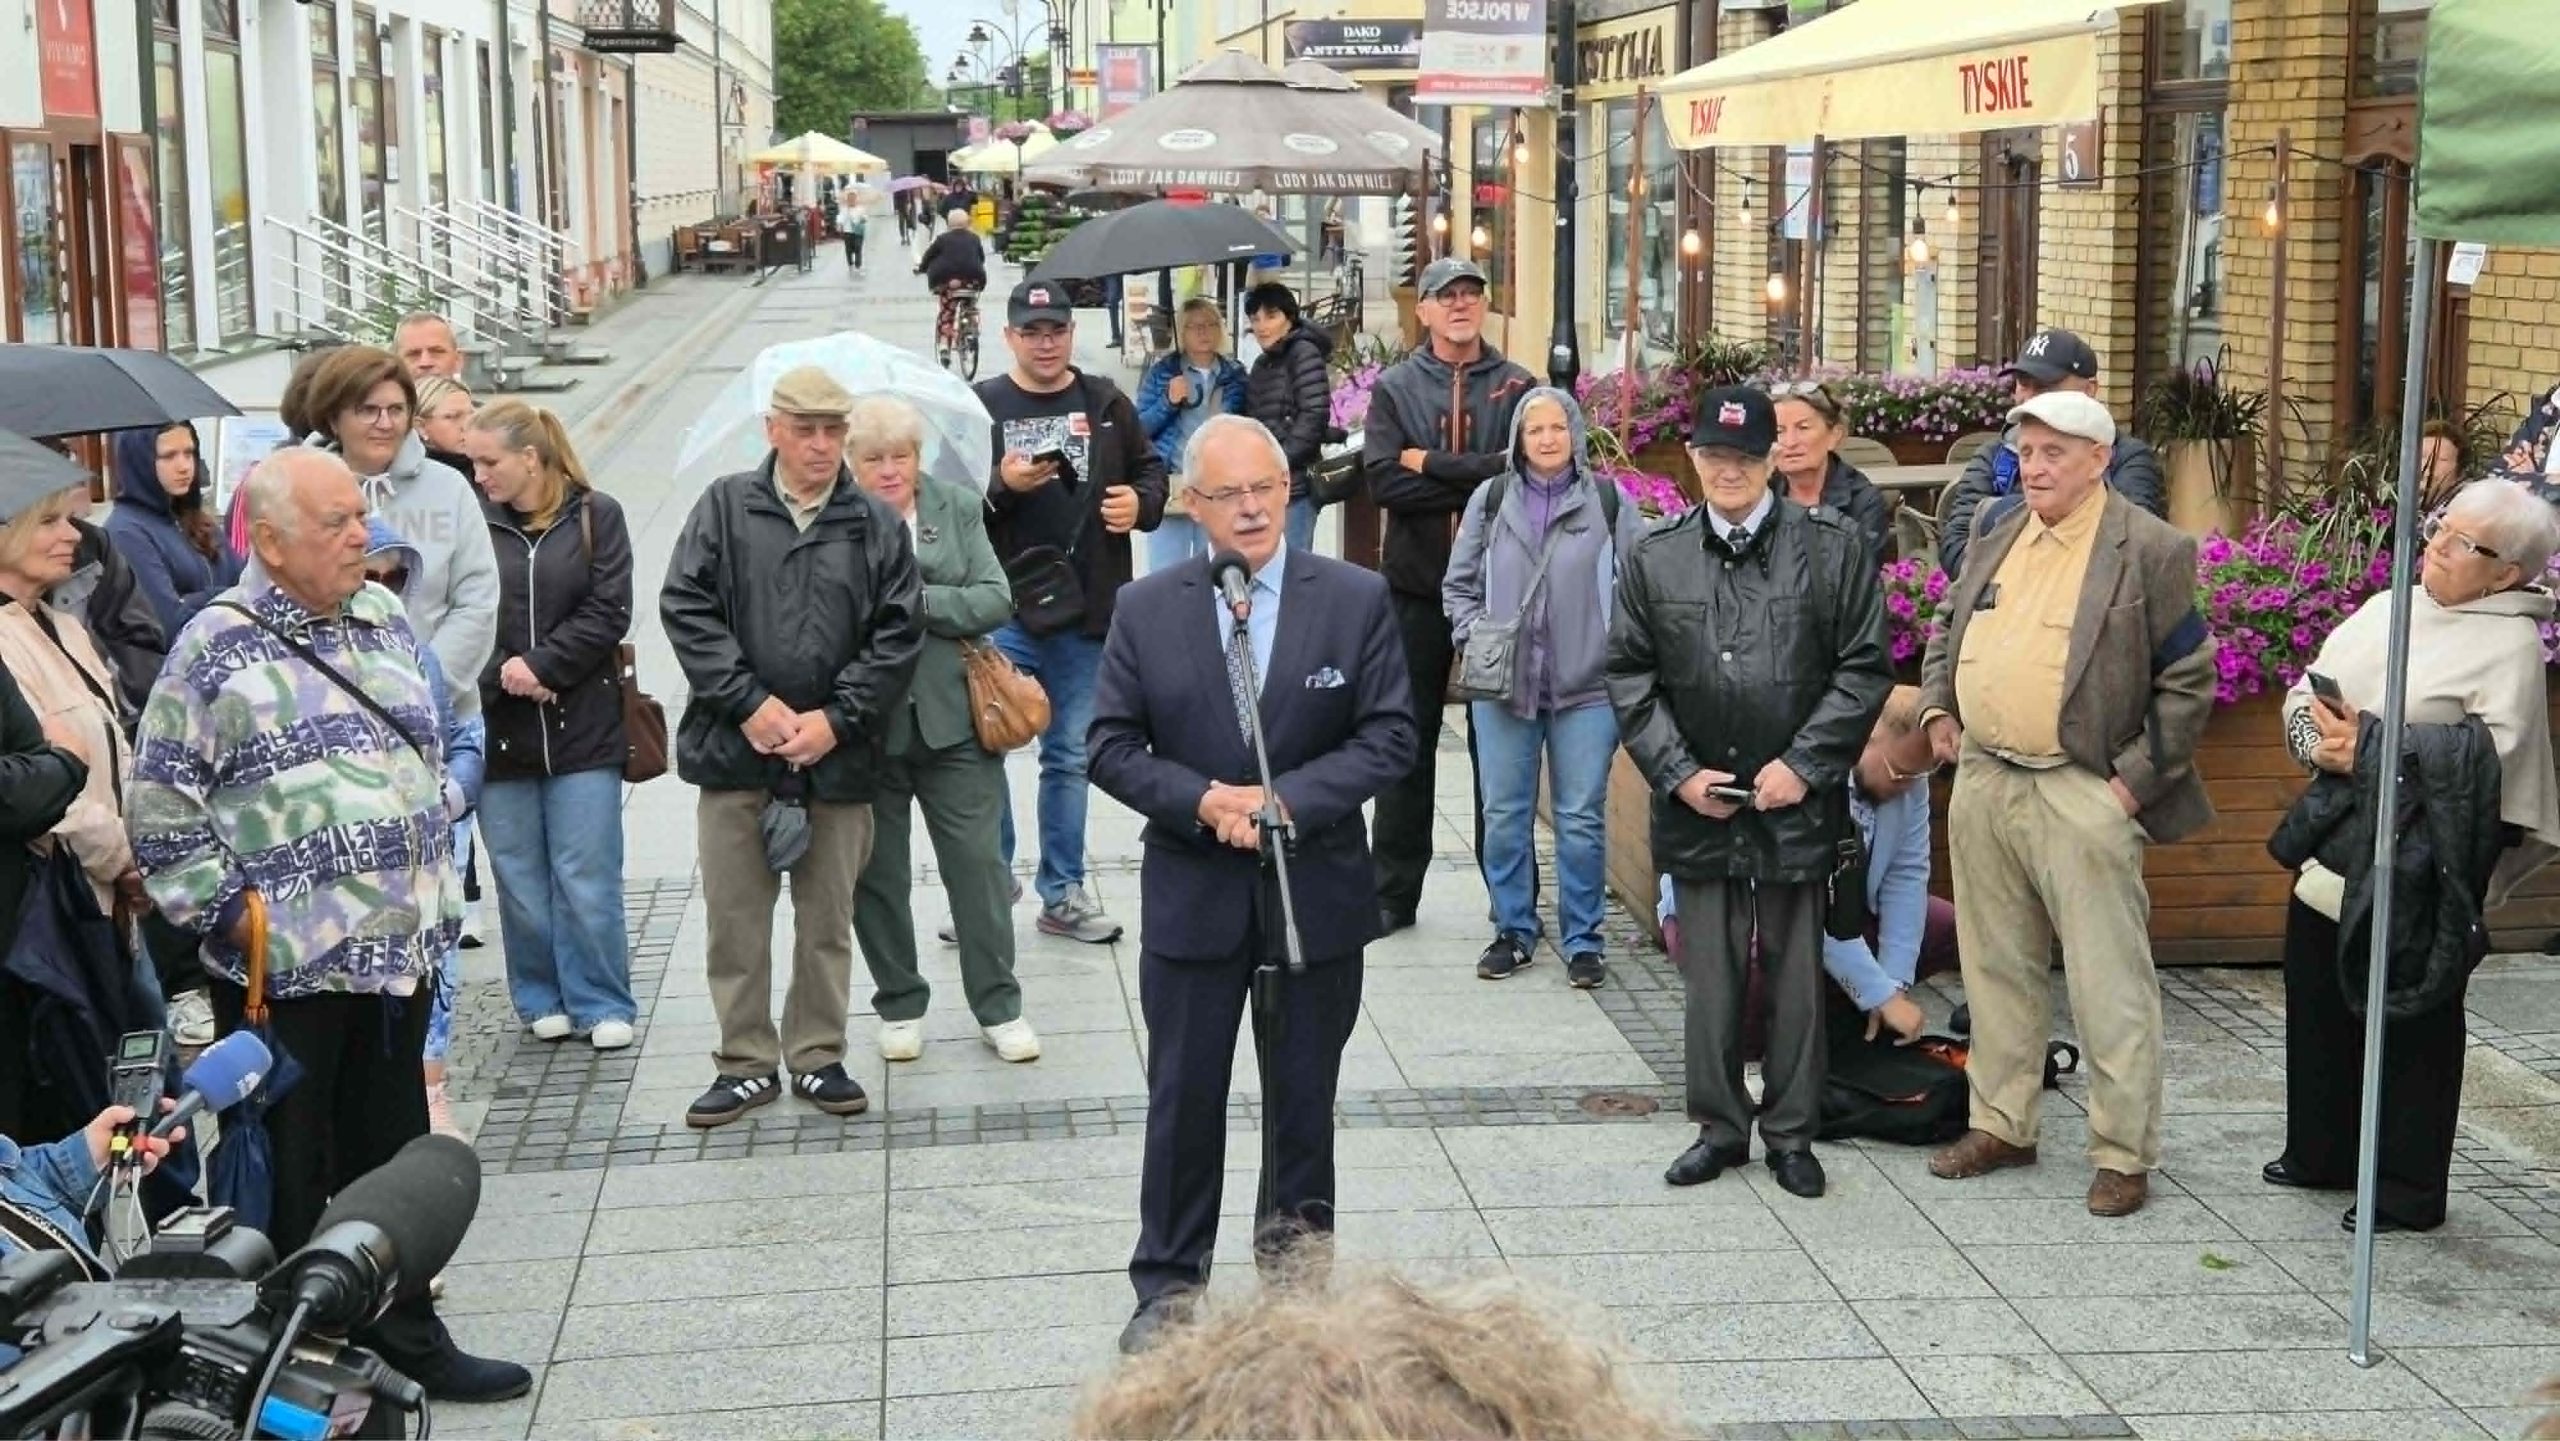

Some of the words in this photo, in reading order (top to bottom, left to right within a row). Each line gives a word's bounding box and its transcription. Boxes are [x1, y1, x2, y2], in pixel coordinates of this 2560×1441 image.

[1343, 26, 1381, 38] DAKO
[1959, 56, 2032, 114] TYSKIE
[2065, 133, 2079, 180] 5
[1109, 168, 1144, 185] LODY
[1148, 168, 1173, 185] JAK
[1175, 168, 1240, 187] DAWNIEJ
[1274, 173, 1308, 188] LODY
[1312, 173, 1337, 188] JAK
[1337, 174, 1392, 190] DAWNIEJ
